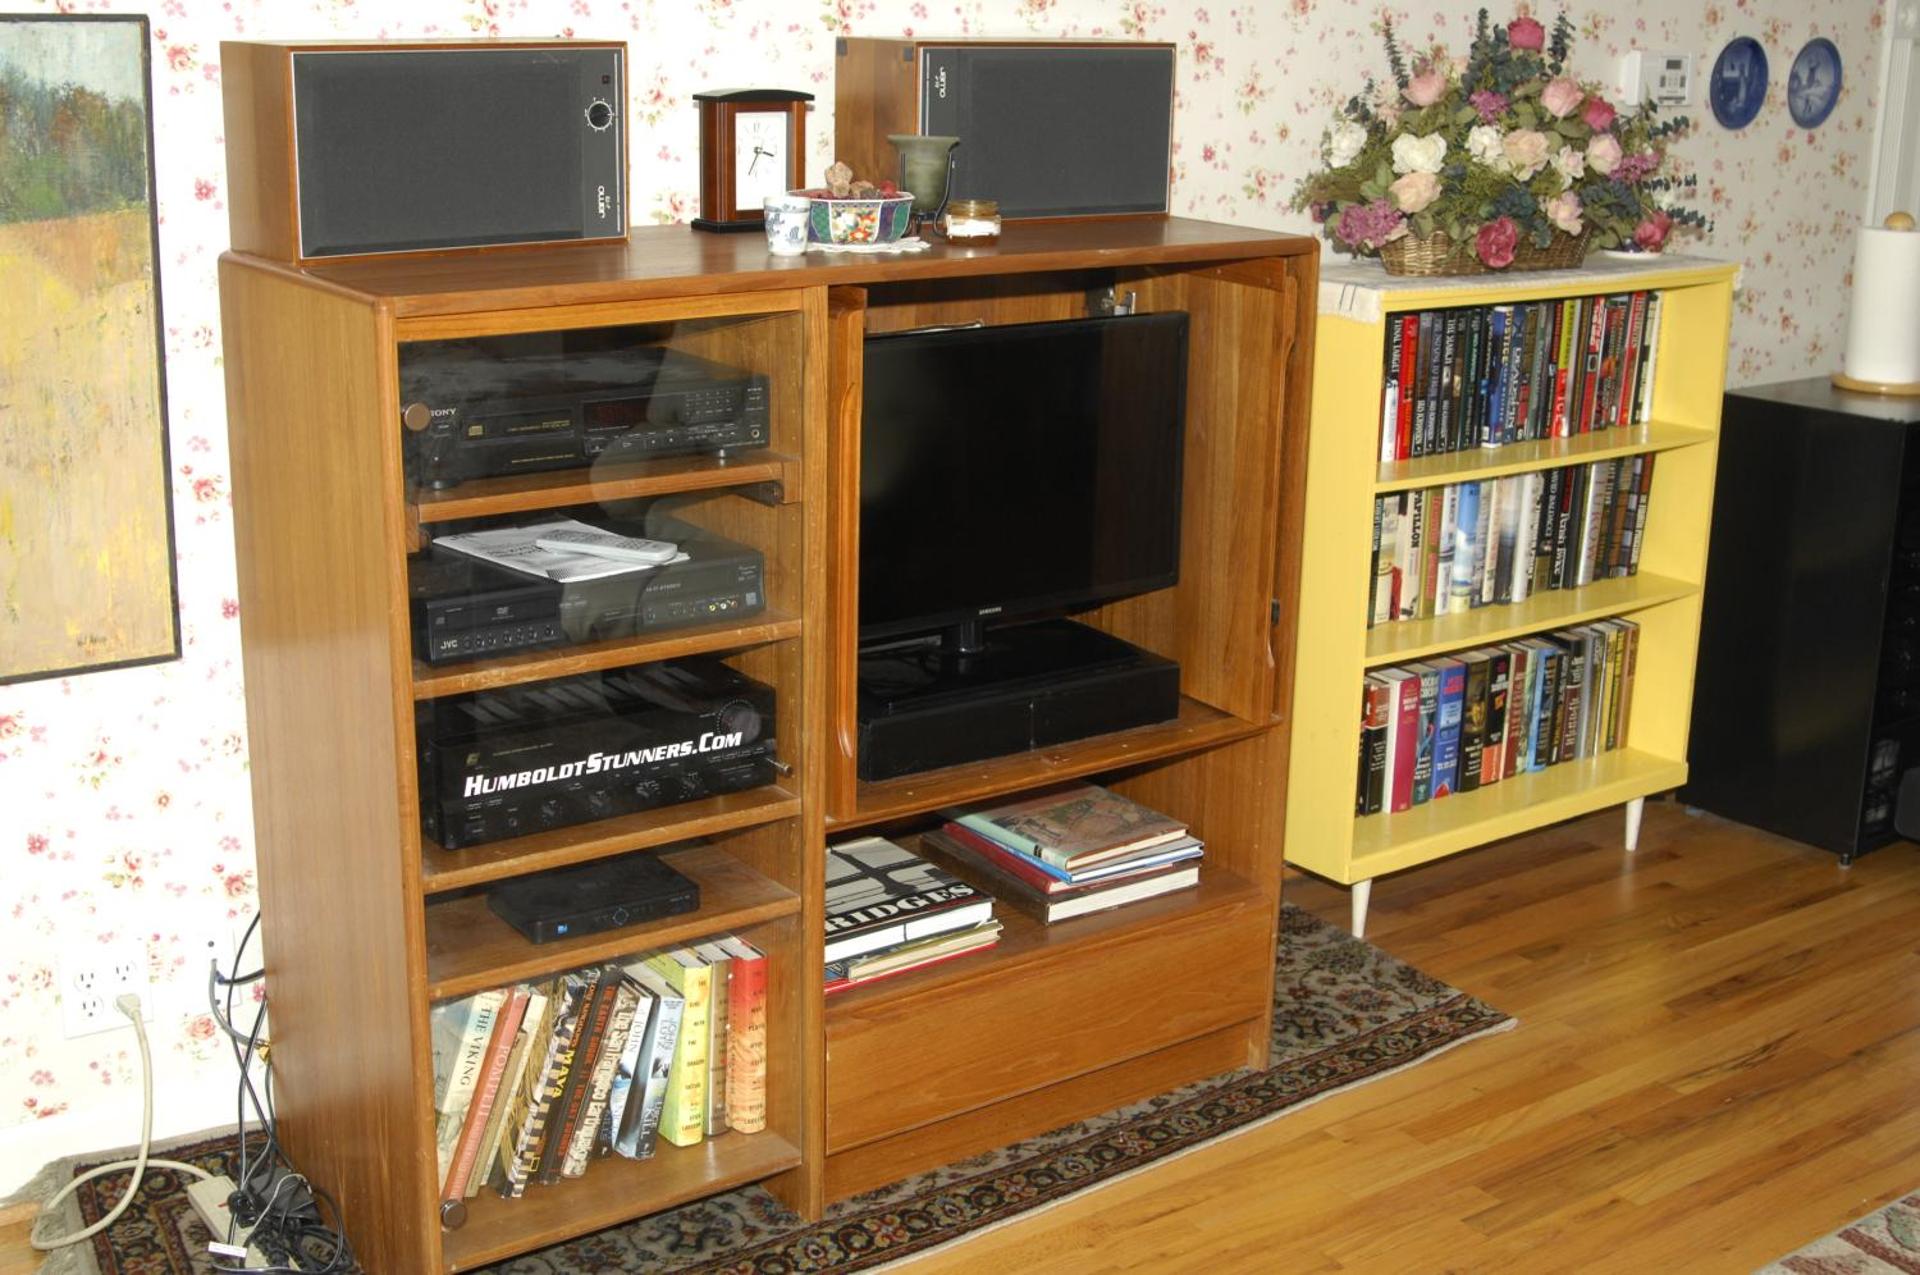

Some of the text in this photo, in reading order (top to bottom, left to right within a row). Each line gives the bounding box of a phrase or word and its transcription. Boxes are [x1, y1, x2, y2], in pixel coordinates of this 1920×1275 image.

[1391, 319, 1403, 372] FINAL TARGET
[1444, 335, 1454, 364] SEARCH
[1501, 310, 1513, 364] JUSTICE
[1409, 489, 1425, 548] PAPILLON
[1543, 494, 1557, 537] BALDACCI
[440, 639, 458, 649] JVC
[825, 884, 974, 932] RIDGES
[606, 1028, 627, 1055] San
[613, 1009, 634, 1031] The
[626, 1020, 645, 1054] JOHN
[457, 1005, 493, 1087] THE VIKING
[550, 1048, 575, 1101] MAYA
[591, 1051, 620, 1103] Francisco
[572, 1099, 606, 1162] Earthquake
[638, 1106, 655, 1140] KILL
